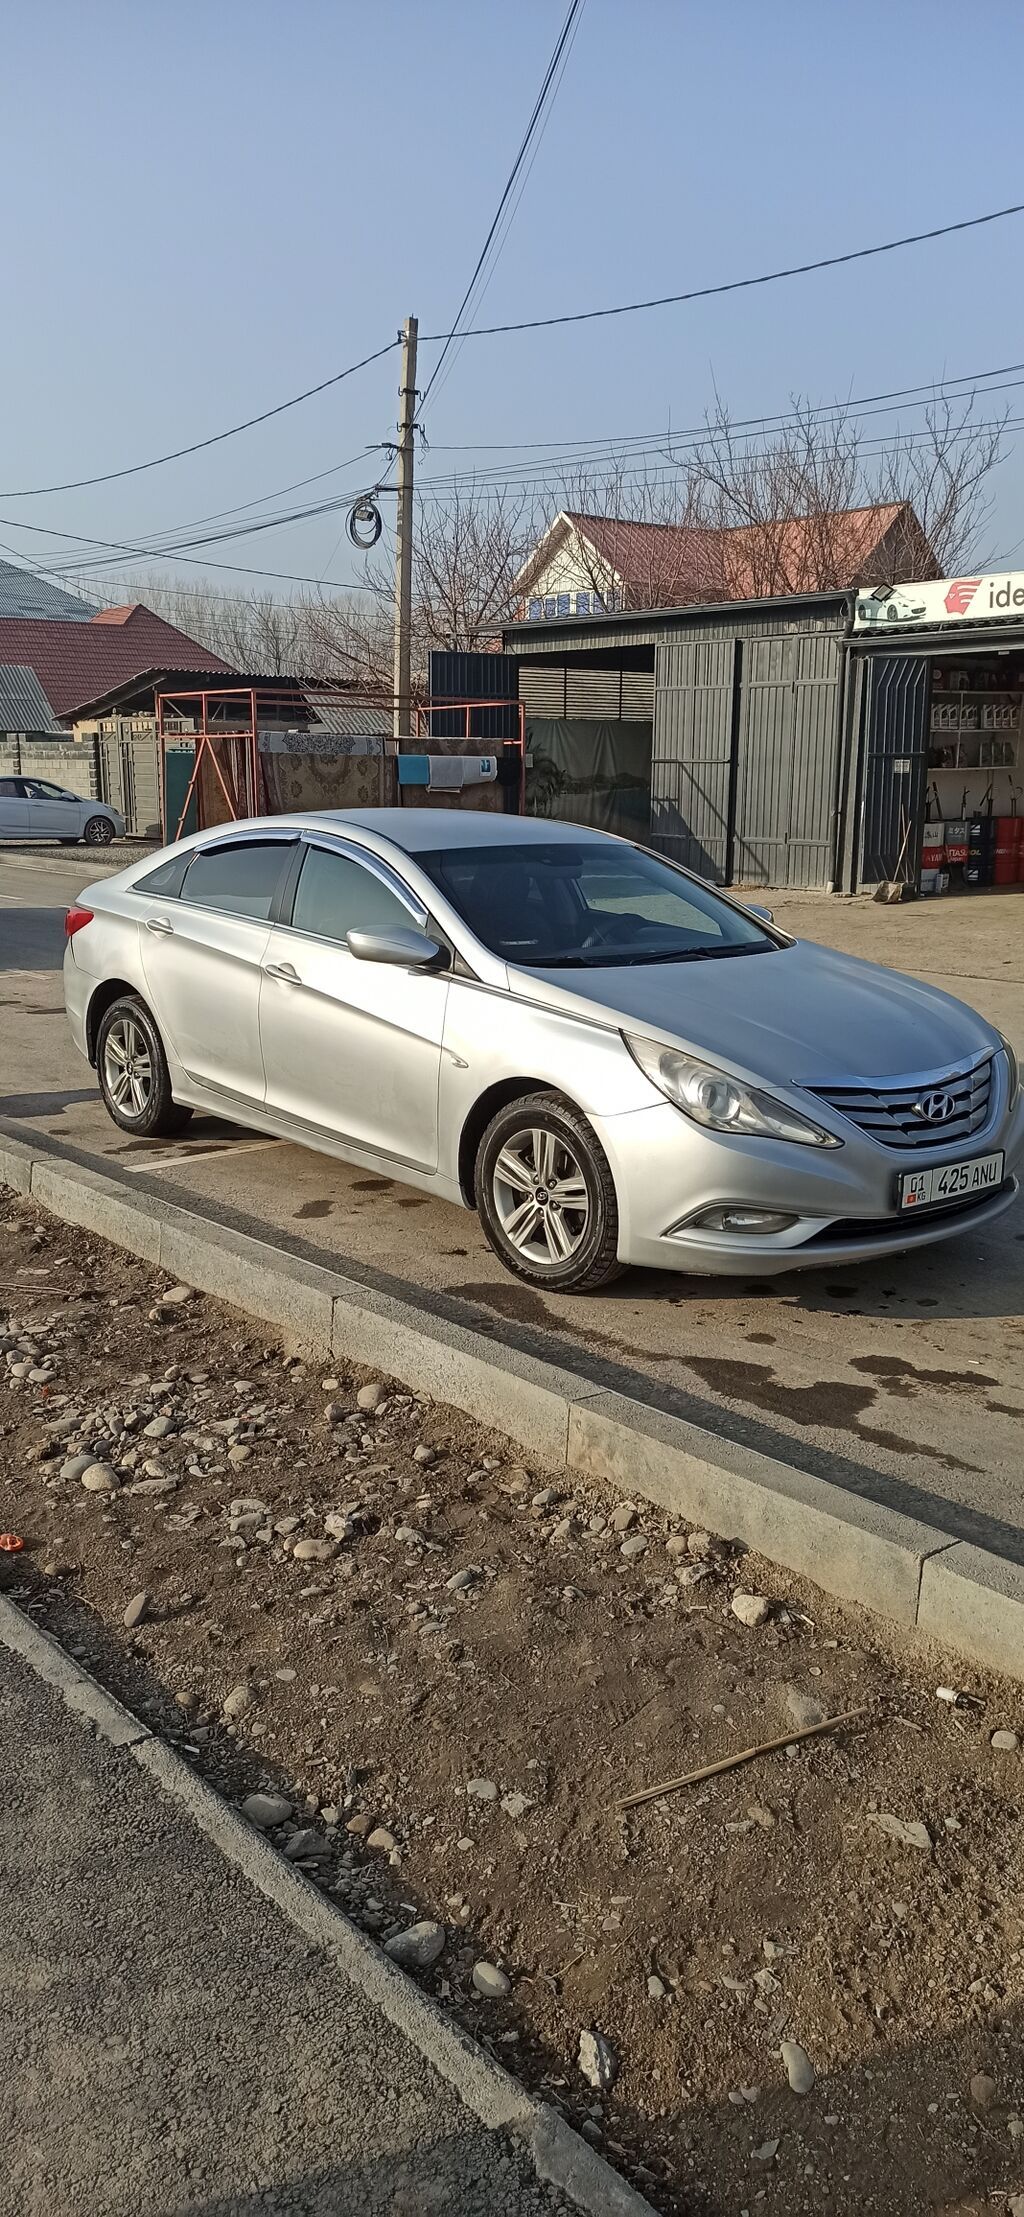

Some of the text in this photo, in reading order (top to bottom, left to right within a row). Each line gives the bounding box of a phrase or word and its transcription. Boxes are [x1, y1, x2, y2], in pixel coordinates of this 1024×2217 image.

[910, 1175, 925, 1193] 01
[938, 1162, 997, 1195] 425 ANU
[917, 1191, 926, 1201] KG
